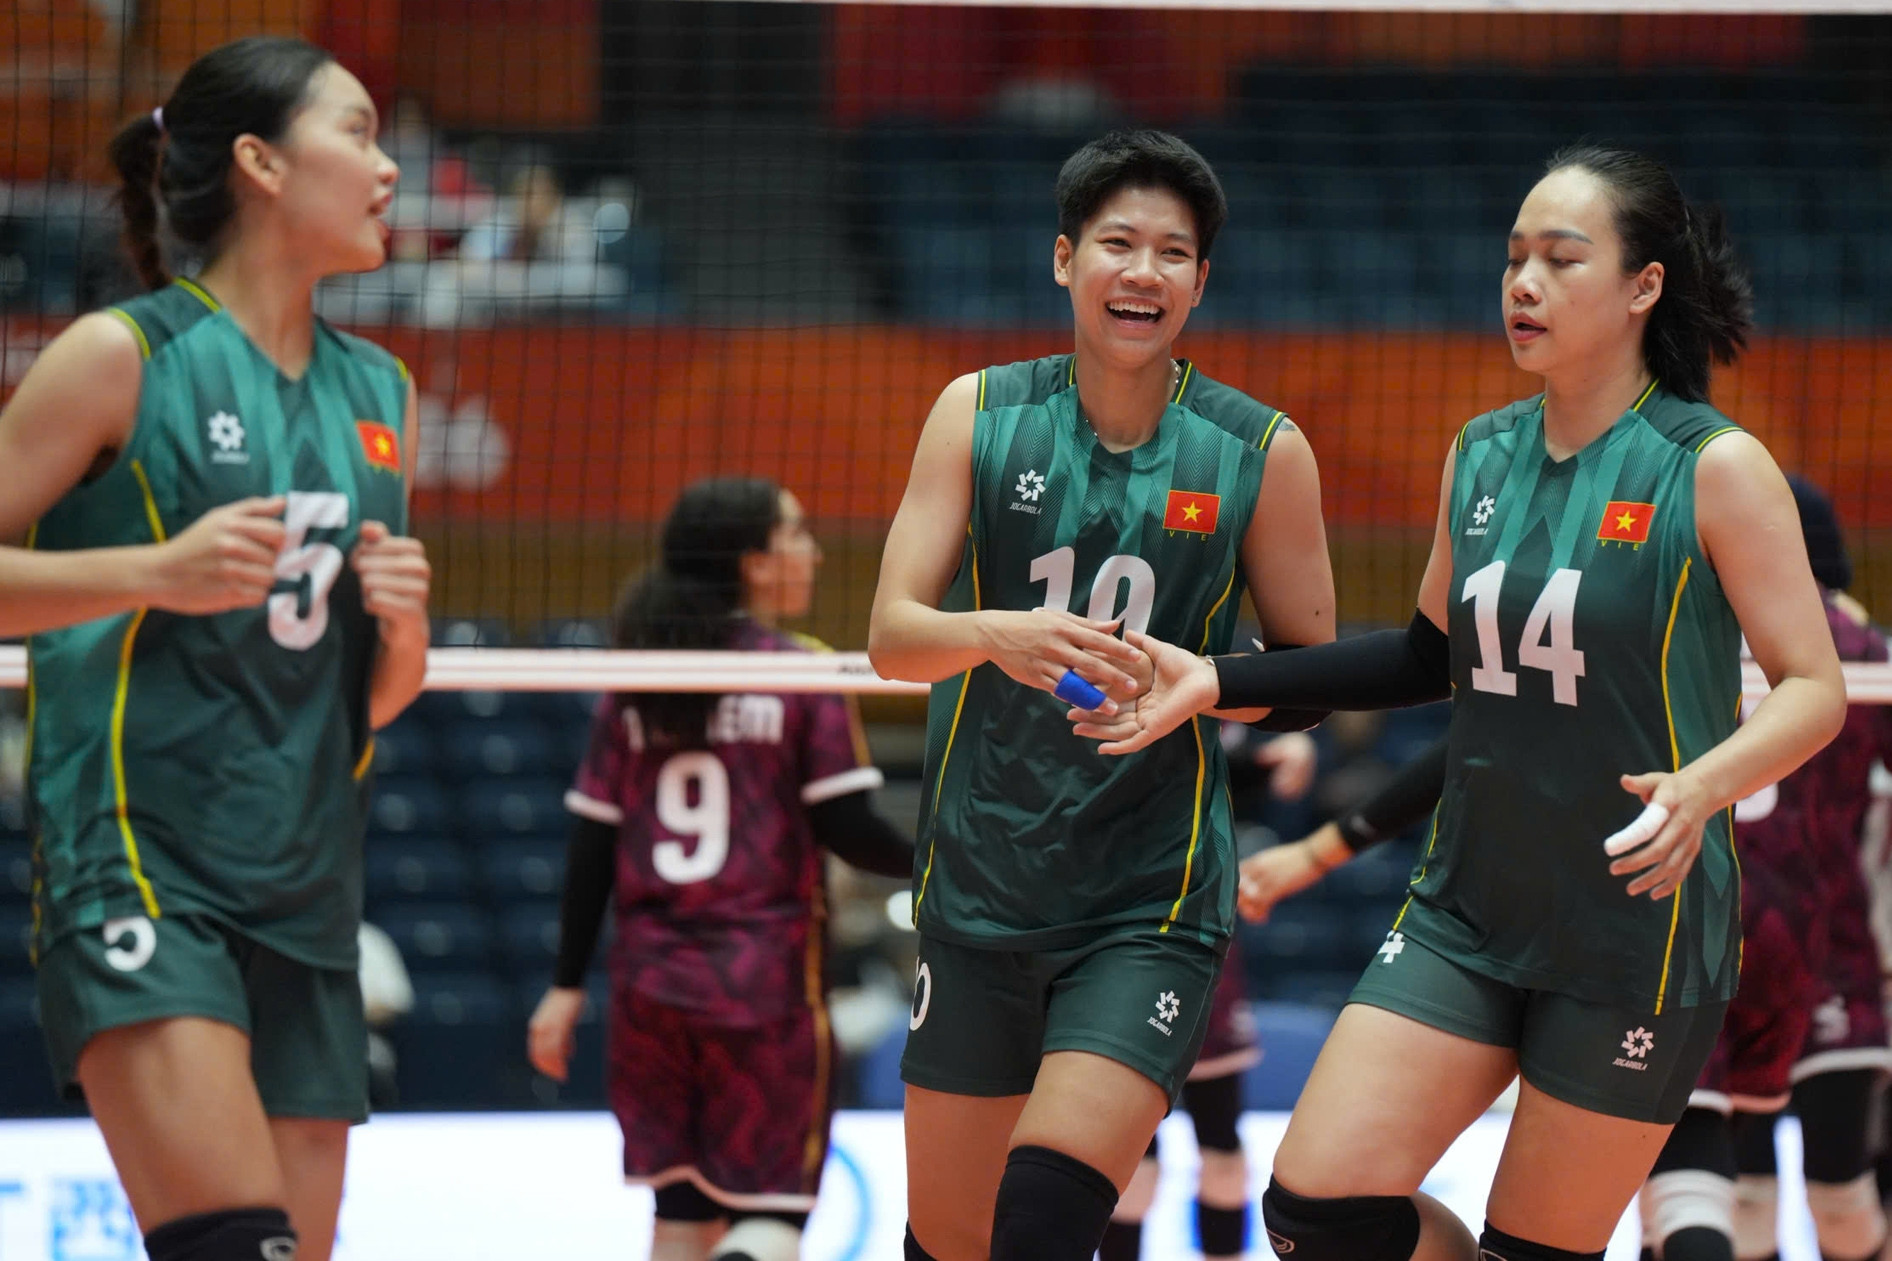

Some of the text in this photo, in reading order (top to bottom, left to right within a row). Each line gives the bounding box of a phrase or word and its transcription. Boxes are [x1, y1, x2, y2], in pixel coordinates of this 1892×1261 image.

[267, 489, 351, 652] 5
[1169, 530, 1207, 541] VIE
[1461, 559, 1586, 707] 14
[652, 751, 730, 884] 9
